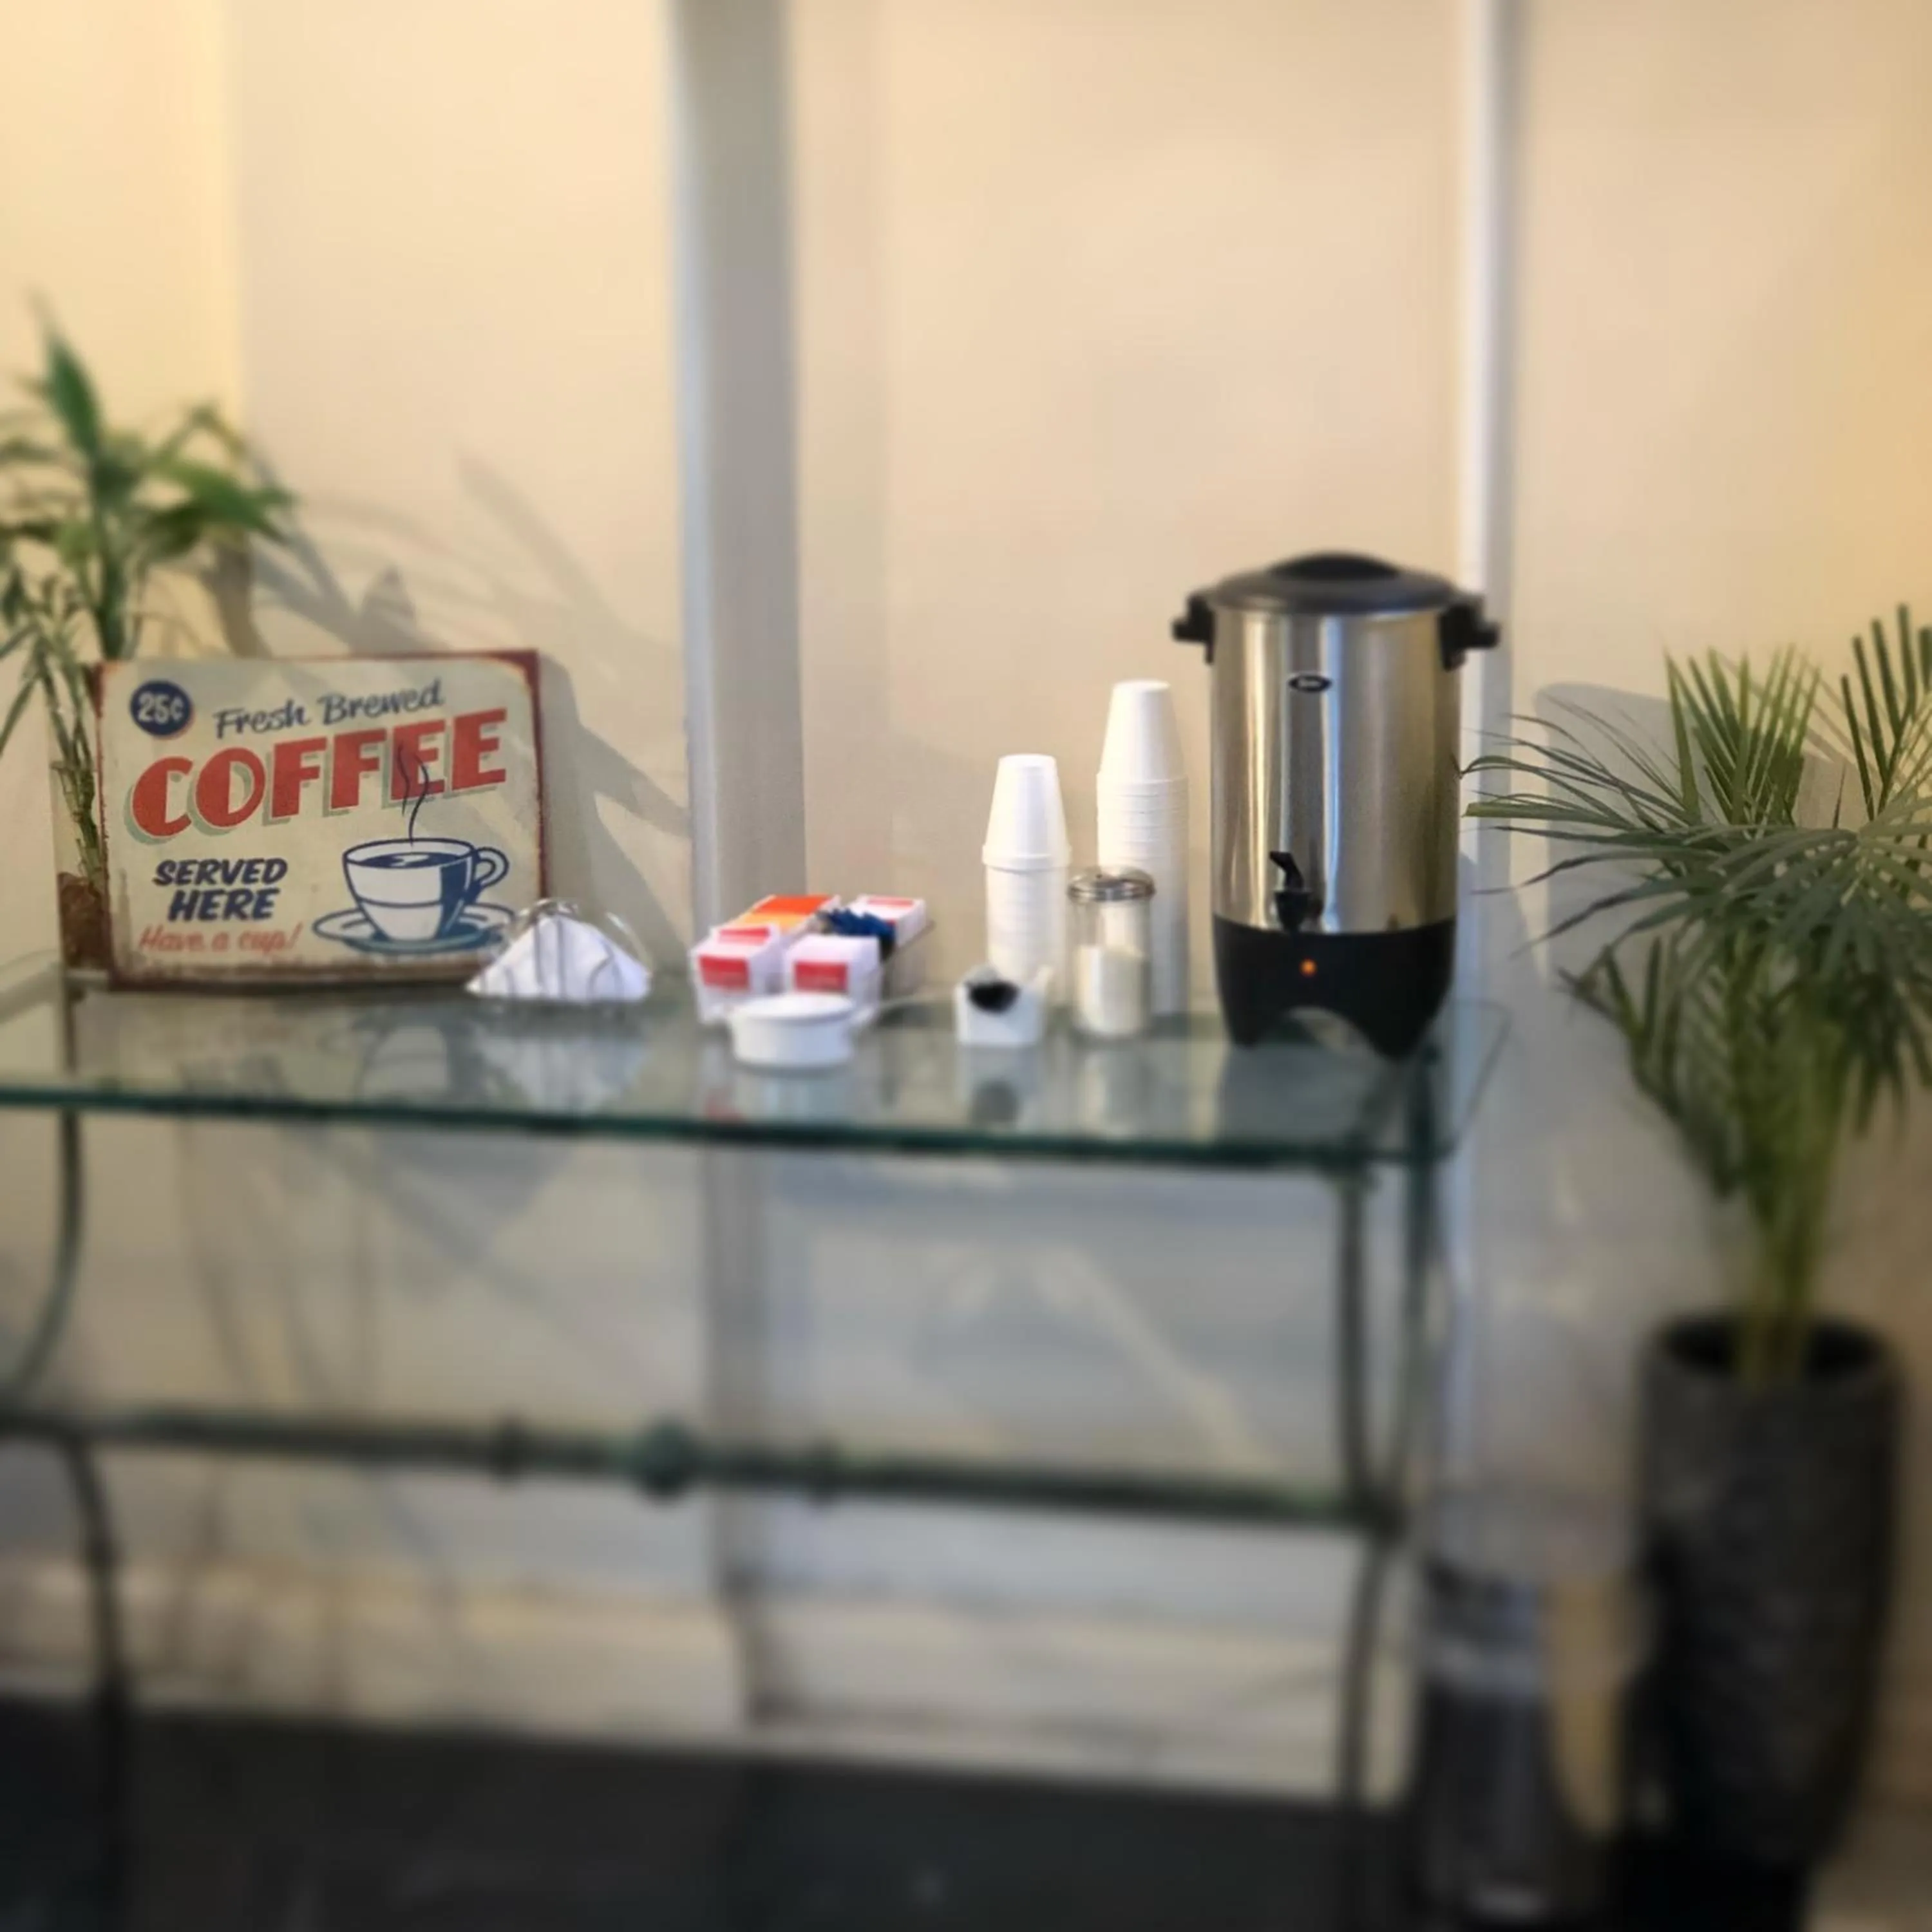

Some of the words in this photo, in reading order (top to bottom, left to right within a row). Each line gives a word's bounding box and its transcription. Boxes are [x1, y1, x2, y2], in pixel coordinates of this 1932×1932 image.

[213, 698, 310, 739] Fresh
[316, 677, 445, 726] Brewed
[123, 707, 507, 845] COFFEE
[152, 857, 288, 886] SERVED
[167, 888, 281, 922] HERE
[138, 922, 205, 951] Have
[212, 931, 229, 951] a
[238, 922, 303, 955] cup!
